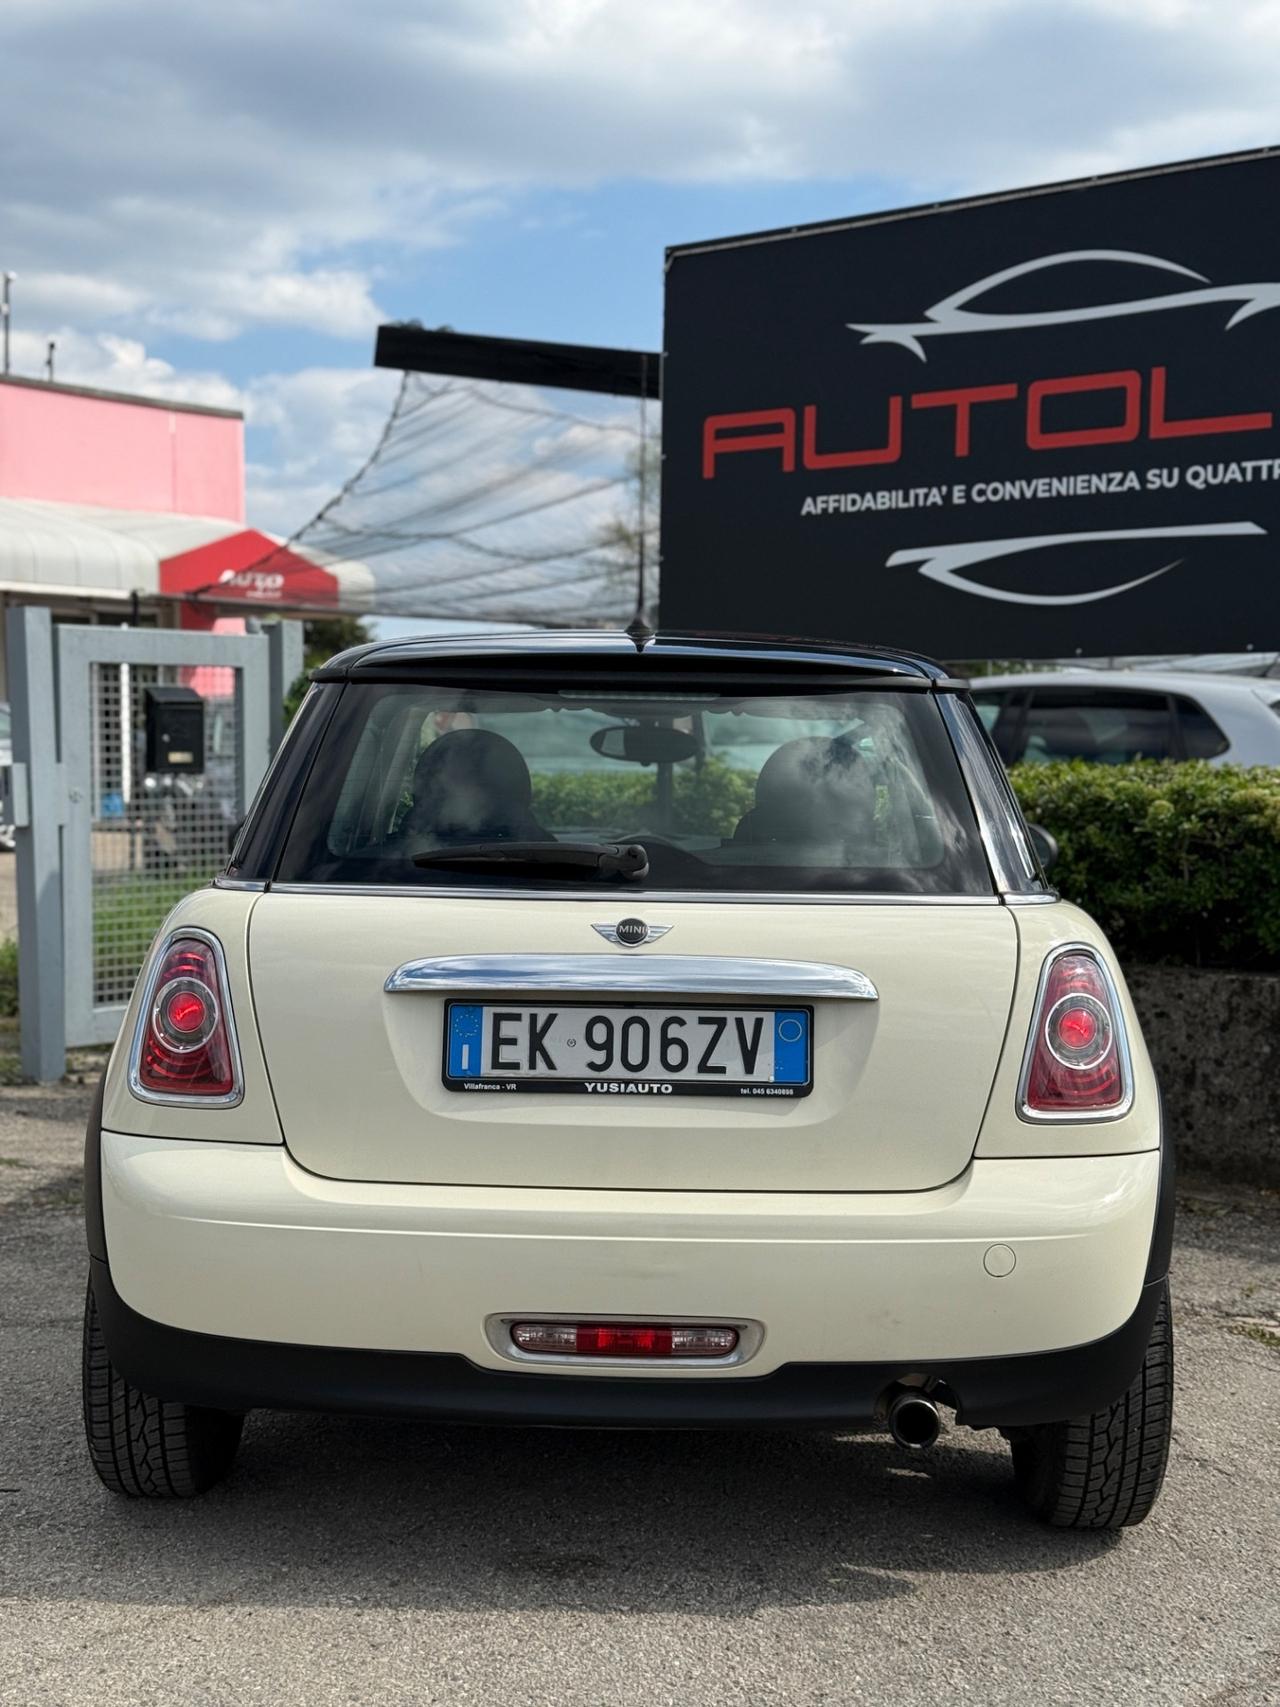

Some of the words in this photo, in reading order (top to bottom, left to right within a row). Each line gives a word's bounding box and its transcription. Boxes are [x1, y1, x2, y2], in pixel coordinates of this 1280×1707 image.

[703, 366, 1273, 479] AUTOL
[952, 485, 967, 504] E
[971, 470, 1141, 503] CONVENIENZA
[1146, 467, 1180, 490] SU
[619, 925, 646, 935] MINI
[490, 1012, 559, 1072] EK
[584, 1015, 765, 1076] 906ZV
[463, 1082, 500, 1090] Villafranca
[584, 1082, 673, 1094] YUSIAUTO
